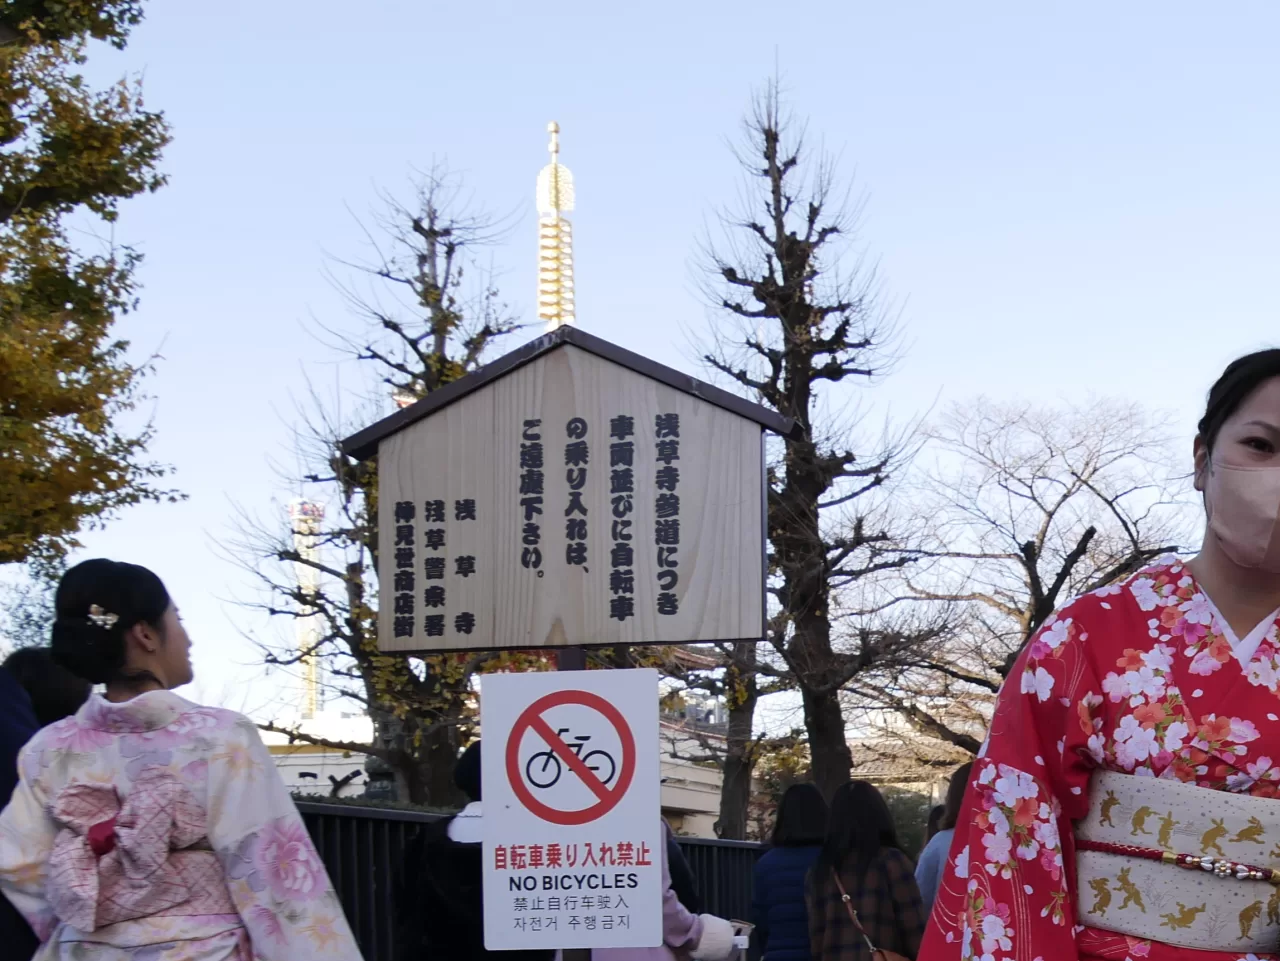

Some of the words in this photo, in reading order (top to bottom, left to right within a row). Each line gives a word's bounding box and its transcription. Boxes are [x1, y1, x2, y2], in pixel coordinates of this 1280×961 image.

[519, 419, 544, 578] ご遠慮下さい。
[564, 417, 589, 573] の乗り入れは、
[610, 415, 634, 621] 車両並びに自転車
[655, 413, 680, 615] 浅草寺参道につき
[394, 501, 416, 638] 仲見世商店街
[424, 500, 446, 637] 浅草警察署
[455, 499, 476, 635] 浅草寺
[494, 841, 652, 870] 自転車乗り入れ禁止
[509, 876, 537, 891] NO
[542, 873, 639, 890] BICYCLES
[513, 894, 630, 912] 禁止自行车驶入
[513, 916, 558, 932] 자전거
